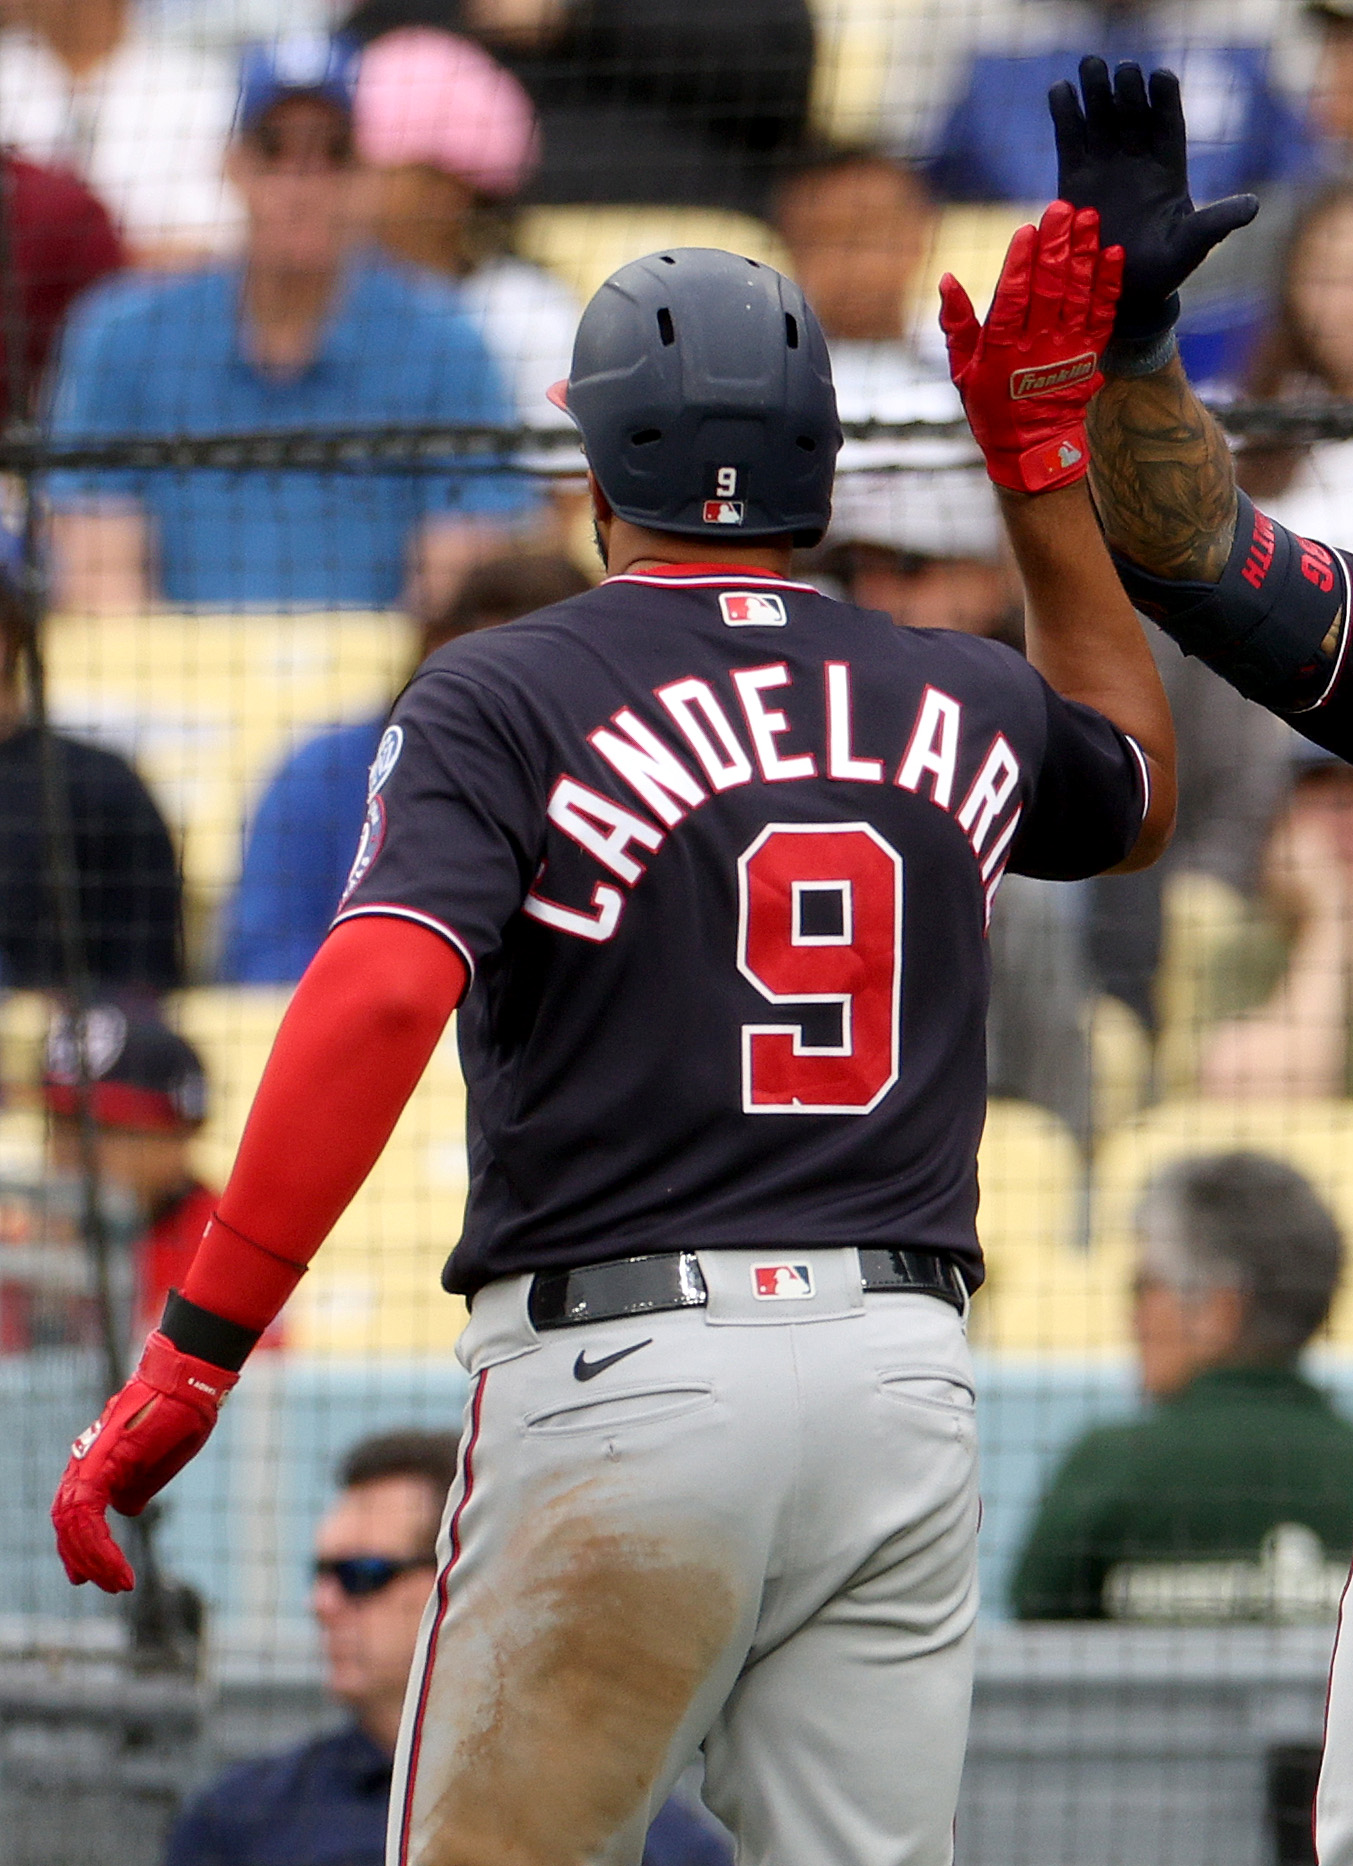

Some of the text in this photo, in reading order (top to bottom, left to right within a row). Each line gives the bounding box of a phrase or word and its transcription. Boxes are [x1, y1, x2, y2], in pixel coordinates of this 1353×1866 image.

[1016, 362, 1093, 395] Franklin
[716, 466, 737, 498] 9
[736, 821, 903, 1115] 9
